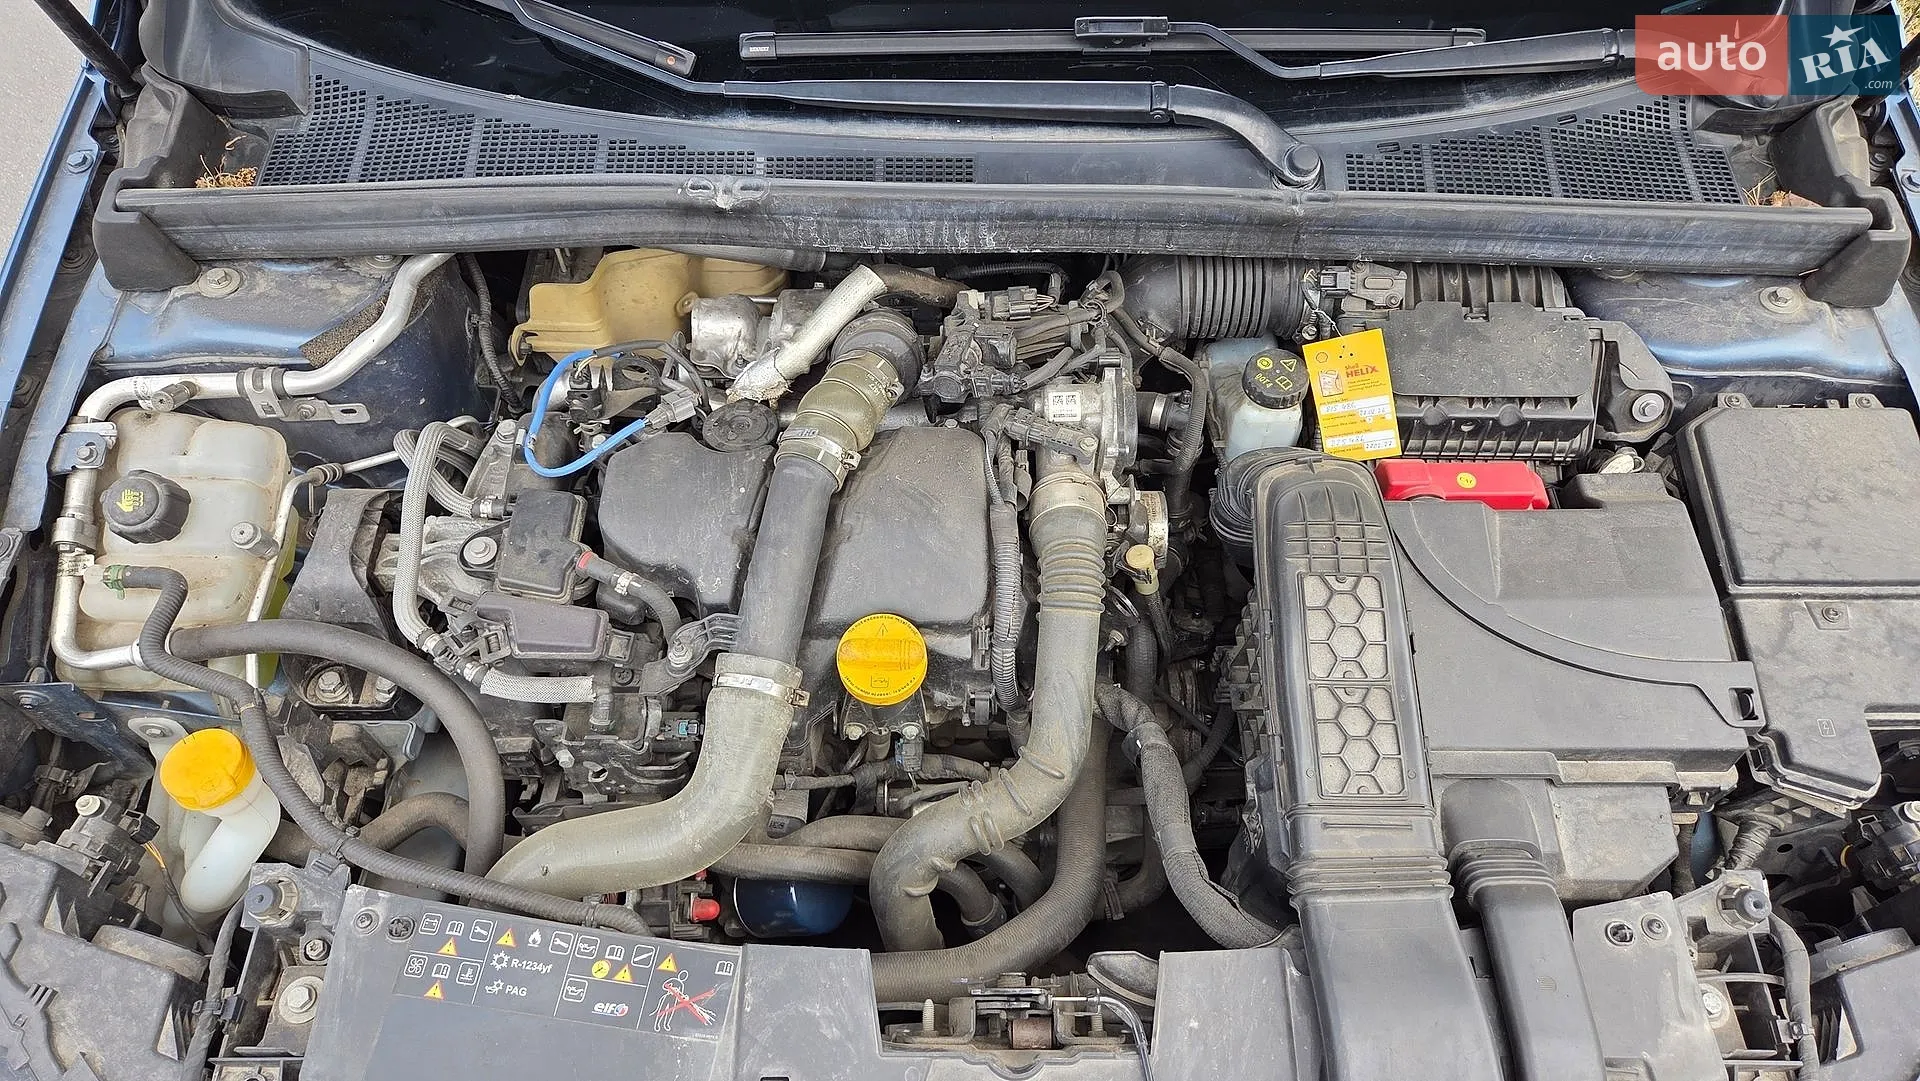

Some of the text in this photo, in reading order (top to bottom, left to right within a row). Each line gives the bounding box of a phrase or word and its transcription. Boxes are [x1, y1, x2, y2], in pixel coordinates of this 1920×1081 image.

[1346, 365, 1379, 378] HELIX
[510, 959, 552, 974] R-1234yf
[505, 984, 527, 997] PAG
[593, 1002, 618, 1016] elf
